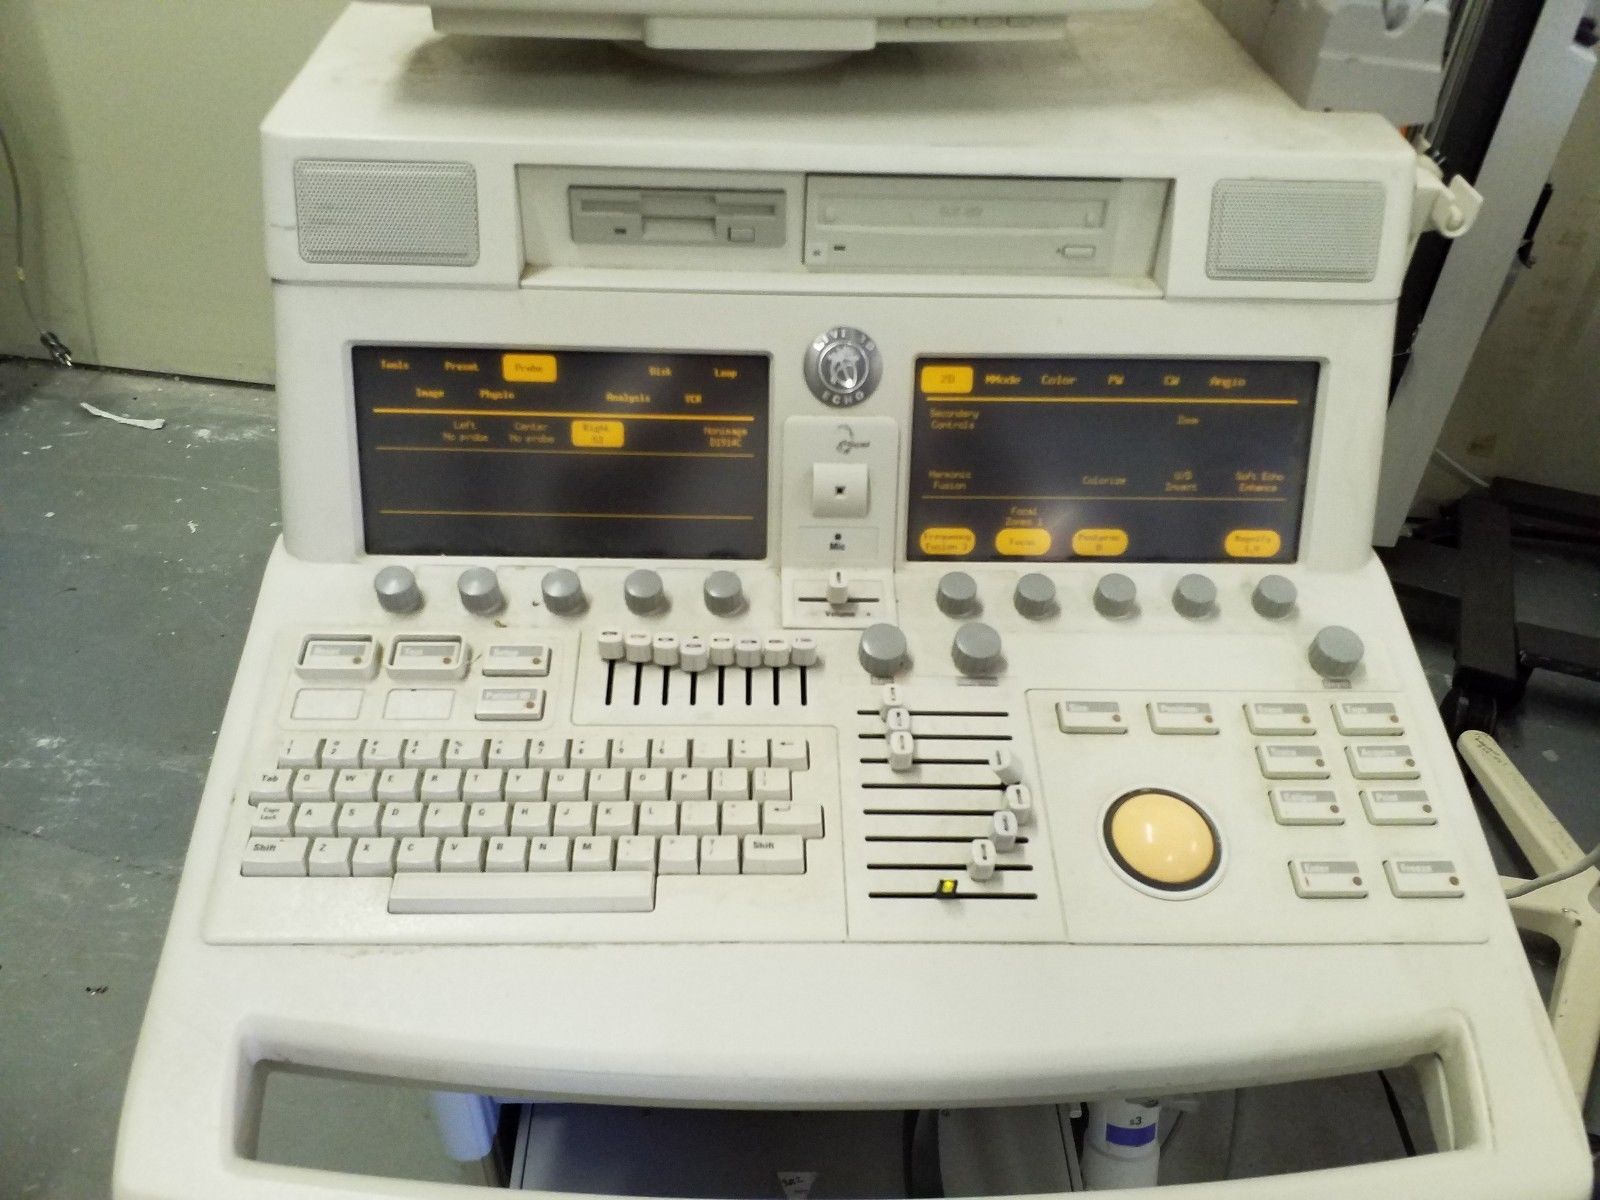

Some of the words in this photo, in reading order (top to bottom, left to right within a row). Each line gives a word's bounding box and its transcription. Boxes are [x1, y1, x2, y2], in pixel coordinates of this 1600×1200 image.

[262, 774, 279, 783] Tab
[253, 843, 277, 852] Shift
[753, 841, 775, 850] Shift
